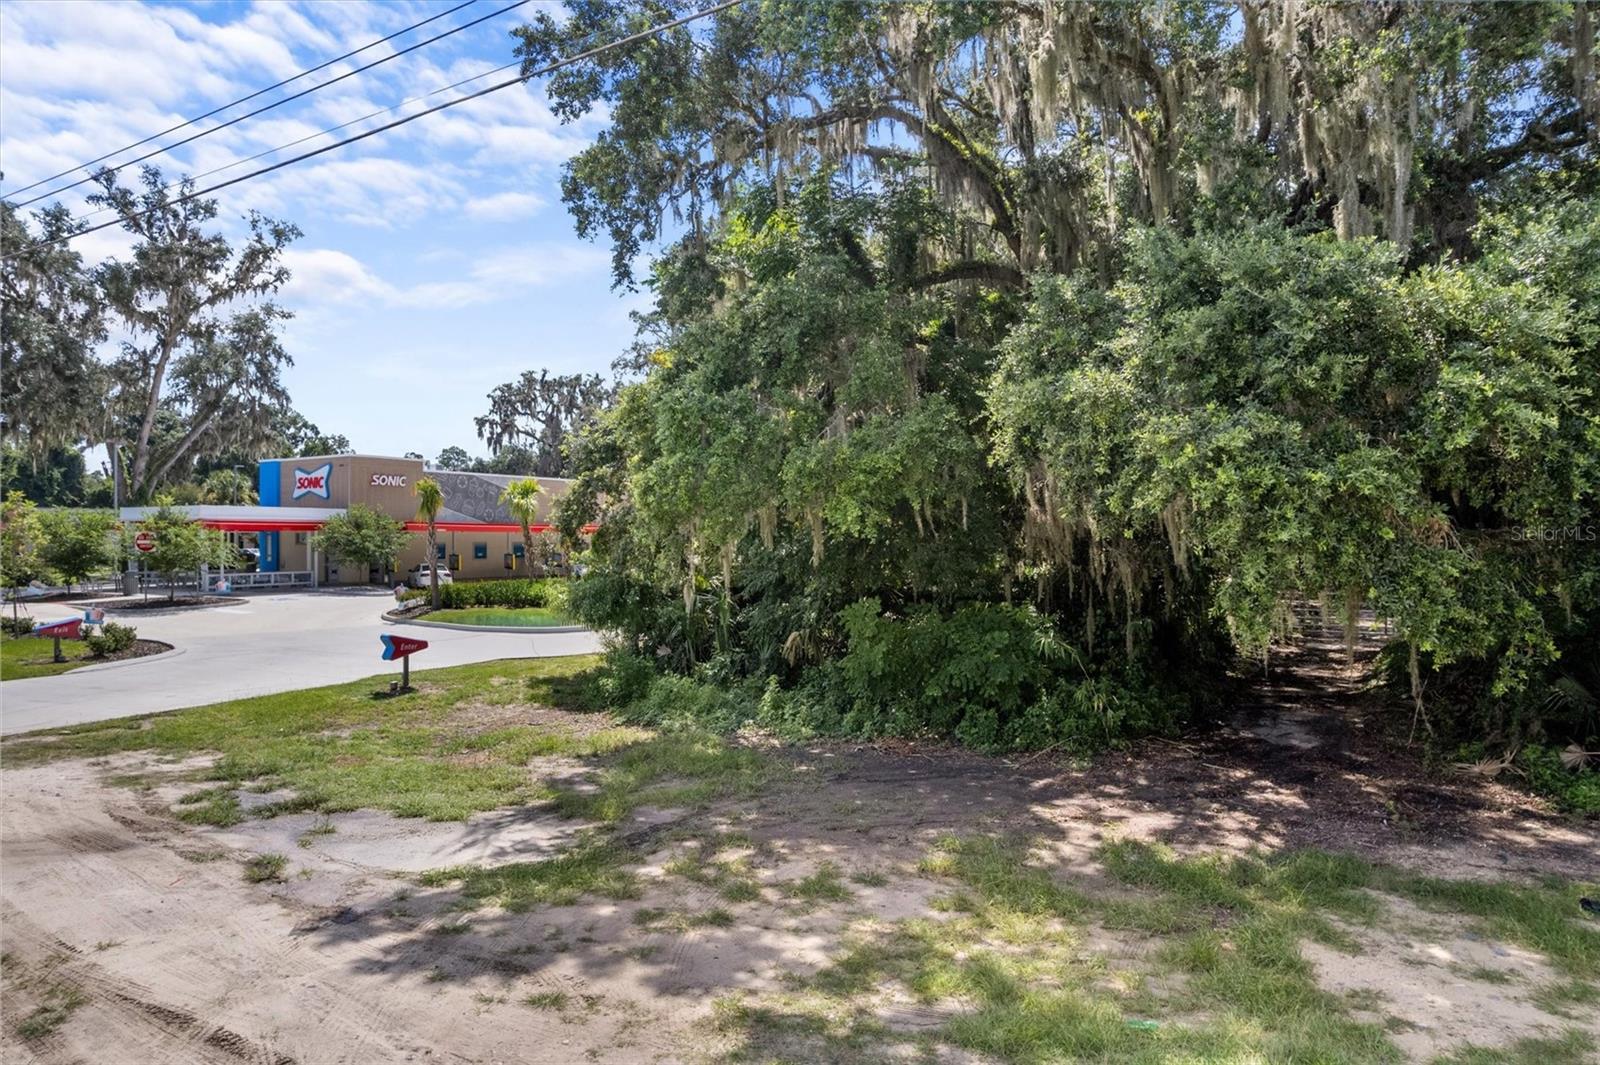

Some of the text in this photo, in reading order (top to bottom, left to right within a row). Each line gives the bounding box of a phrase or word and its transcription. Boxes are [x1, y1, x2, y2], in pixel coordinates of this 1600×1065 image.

[297, 476, 325, 489] SONIC
[371, 474, 407, 487] SONIC
[400, 643, 418, 651] Enter
